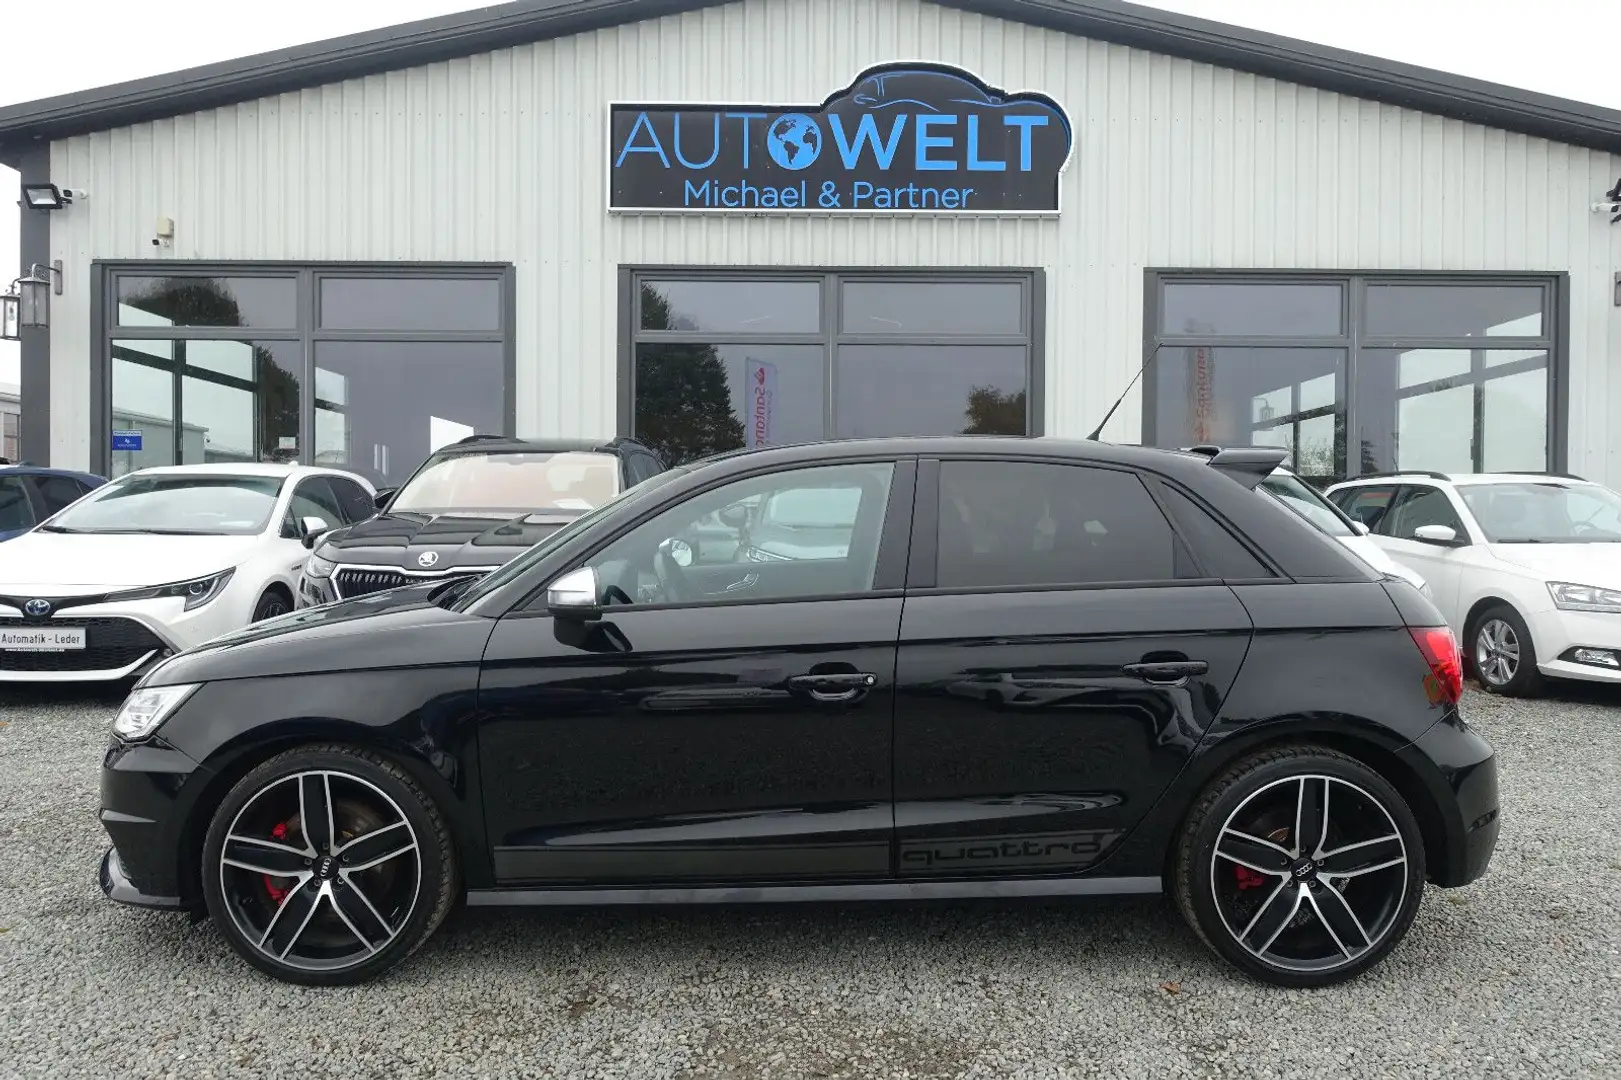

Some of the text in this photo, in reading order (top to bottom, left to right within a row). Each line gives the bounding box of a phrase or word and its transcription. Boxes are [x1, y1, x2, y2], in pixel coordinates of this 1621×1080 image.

[684, 180, 974, 209] Michael & Partner
[1, 633, 46, 644] Automatik
[55, 633, 81, 644] Leder
[903, 840, 1101, 865] quattro
